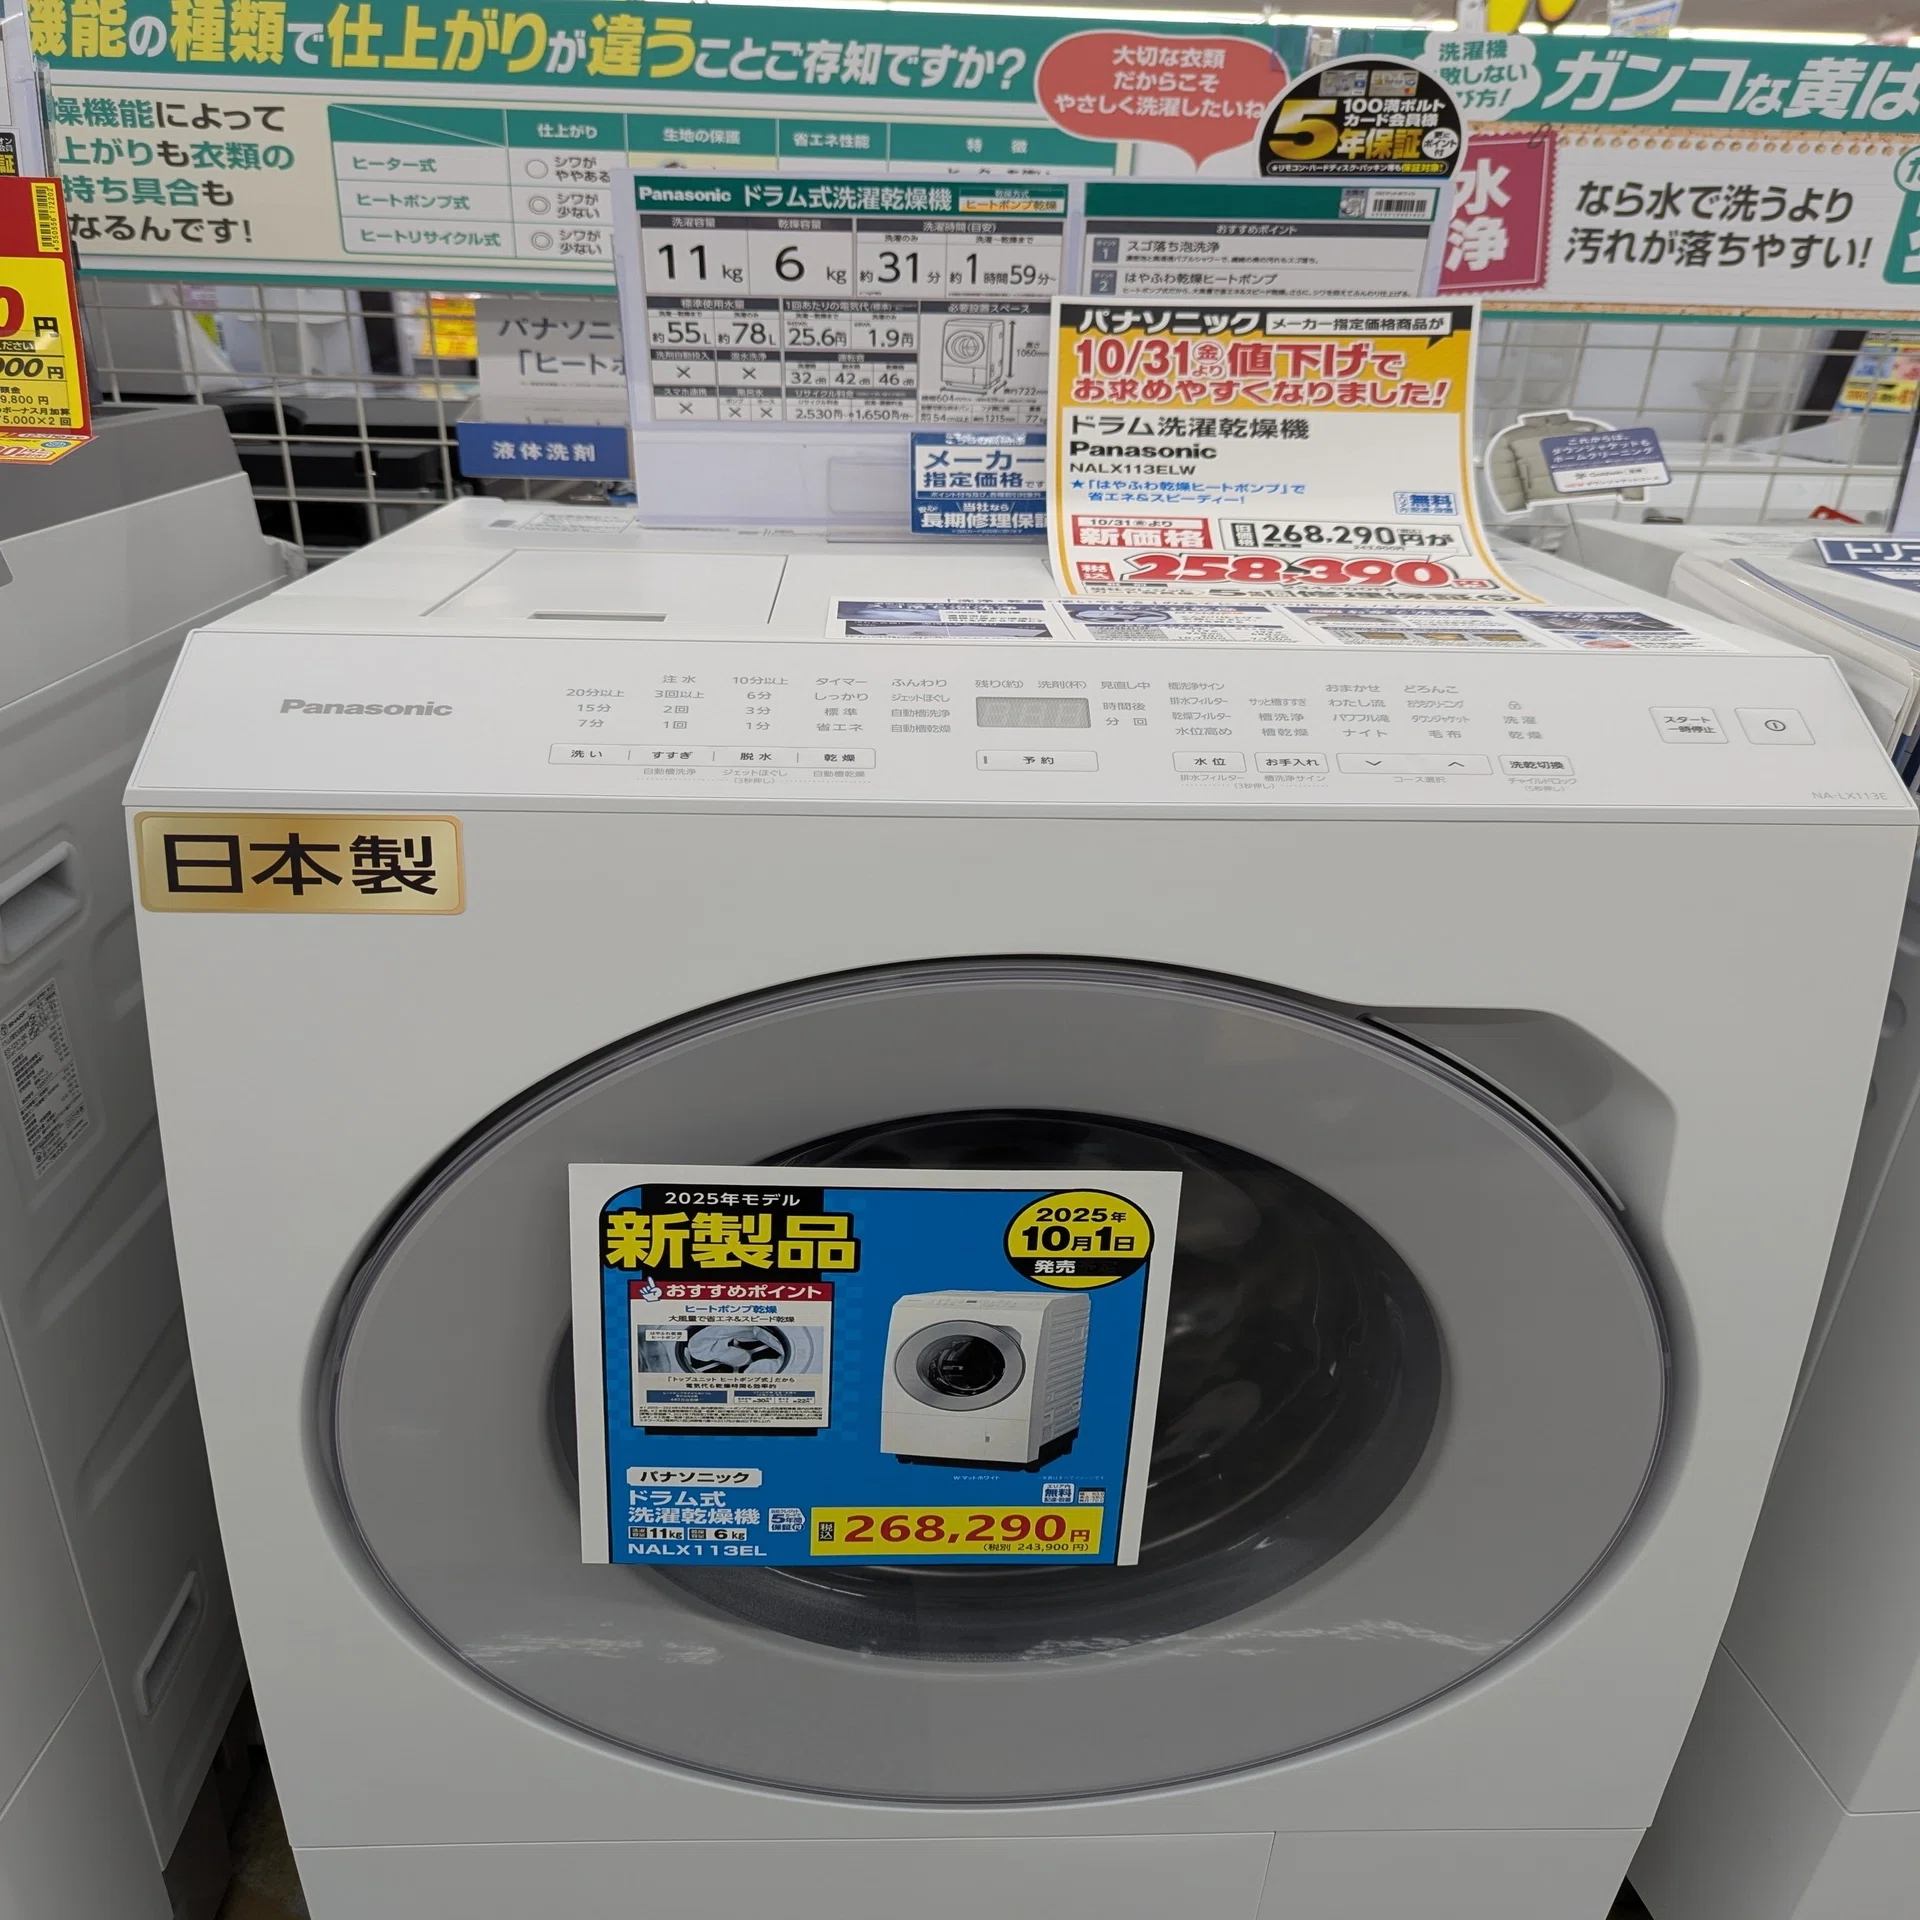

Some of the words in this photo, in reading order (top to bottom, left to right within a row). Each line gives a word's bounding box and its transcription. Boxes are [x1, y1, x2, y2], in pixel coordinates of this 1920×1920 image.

[1439, 40, 1508, 62] 洗濯機
[1113, 47, 1226, 70] 大切な衣類
[1434, 64, 1527, 85] 敗しない
[1113, 71, 1220, 93] だからこそ
[1056, 94, 1264, 120] やさしく洗濯したいね
[1343, 98, 1446, 113] 100満ボルト
[1343, 114, 1438, 127] カード会員様
[537, 123, 598, 139] 仕上がり
[663, 128, 741, 145] 生地の保護
[793, 132, 869, 149] 省エネ性能
[1424, 139, 1458, 148] ポイント
[59, 136, 294, 169] 上がりも衣類の
[352, 157, 437, 173] ヒーター式
[554, 156, 597, 170] シワが
[62, 175, 234, 208] 持ち具合も
[356, 193, 470, 210] ヒートポンプ式
[556, 193, 599, 206] シワが
[639, 186, 732, 203] Panasonic
[744, 186, 952, 211] ドラム式洗濯乾燥機
[966, 199, 1056, 211] ヒートポンプ乾燥
[1575, 181, 1853, 223] なら水で洗うより
[556, 206, 600, 219] 少ない
[672, 217, 716, 228] 洗濯容量
[778, 219, 821, 230] 乾燥容量
[923, 222, 996, 234] 洗濯時間(目安)
[559, 230, 601, 243] シワが
[1216, 224, 1298, 236] おすすめポイント
[361, 229, 501, 247] ヒートリサイクル式
[884, 234, 918, 243] 洗濯のみ
[1127, 240, 1220, 254] スゴ落ち泡洗浄
[1564, 227, 1873, 268] 汚れが落ちやすい!
[659, 244, 707, 280] 11
[722, 265, 743, 283] kg
[775, 246, 805, 282] 6
[827, 267, 847, 285] kg
[1125, 273, 1278, 286] はやふわ乾燥ヒートポンプ
[681, 299, 745, 310] 標準使用水量
[948, 303, 1030, 314] 必要設置スペース
[498, 316, 623, 341] パナソニ
[1078, 309, 1261, 335] パナソニック
[1271, 317, 1445, 332] メーカー指定価格商品が
[1076, 339, 1192, 377] 10/31
[1228, 342, 1405, 378] 値下げで
[791, 371, 812, 385] 32
[835, 372, 856, 386] 42
[879, 373, 900, 386] 46
[1073, 380, 1449, 408] お求めやすくなりました!
[1071, 415, 1310, 440] ドラム洗濯乾燥機
[492, 440, 596, 462] 液体洗剤
[1070, 441, 1218, 460] Panasonic
[1553, 446, 1654, 463] ホームクリーニング
[924, 450, 1045, 471] メーカー
[1070, 463, 1196, 476] NALX113ELW
[924, 472, 1046, 489] 指定価格です
[963, 502, 1010, 512] 当社なら
[1409, 494, 1452, 508] 無料
[1079, 527, 1205, 548] 新価格
[662, 675, 697, 684] 注水
[732, 676, 788, 686] 10分以上
[816, 677, 868, 687] タイマー
[891, 678, 947, 688] ふんわり
[974, 679, 1024, 689] 残り(約)
[1037, 680, 1087, 690] 洗剤(杯)
[1100, 680, 1151, 690] 見直し中
[565, 688, 625, 698] 20分以上
[1168, 682, 1225, 691] 槽洗浄サイン
[1325, 684, 1381, 693] おまかせ
[1403, 685, 1459, 694] どろんこ
[654, 689, 705, 699] 3回以上
[814, 692, 869, 702] しっかり
[891, 693, 950, 703] ジェットほぐし
[279, 698, 454, 717] Panasonic
[1102, 702, 1146, 711] 時間後
[1249, 698, 1307, 707] サッと槽すすぎ
[891, 708, 950, 718] 自動槽洗浄
[1171, 711, 1231, 721] 乾燥フィルター
[1333, 714, 1390, 723] パワフル滝
[1663, 716, 1711, 724] スタート
[816, 723, 864, 732] 省エネ
[1175, 727, 1233, 736] 水位高め
[1342, 729, 1388, 738] ナイト
[1667, 725, 1716, 735] 一時停止
[570, 749, 603, 759] 洗い
[651, 751, 693, 760] すすぎ
[740, 752, 772, 761] 脱水
[823, 753, 856, 763] 乾燥
[1022, 755, 1054, 765] 予約
[1194, 757, 1226, 766] 水位
[1265, 758, 1320, 767] お手入れ
[1509, 760, 1565, 770] 洗乾切換
[163, 832, 439, 896] 日本製
[664, 1192, 801, 1207] 2025年モデル
[1035, 1207, 1127, 1223] 2025年
[605, 1211, 856, 1270] 新製品
[1021, 1226, 1136, 1253] 10月1日
[666, 1283, 822, 1299] おすすめポイント
[684, 1304, 778, 1315] ヒートポンプ乾燥
[640, 1471, 750, 1484] パナソニック
[629, 1489, 726, 1508] ドラム式
[1045, 1489, 1072, 1497] 無料
[628, 1507, 761, 1525] 洗濯乾燥機
[820, 1522, 834, 1540] 税込
[844, 1514, 1090, 1544] 268,290円
[628, 1543, 768, 1557] NALX113EL
[1018, 1543, 1069, 1553] 243,900
